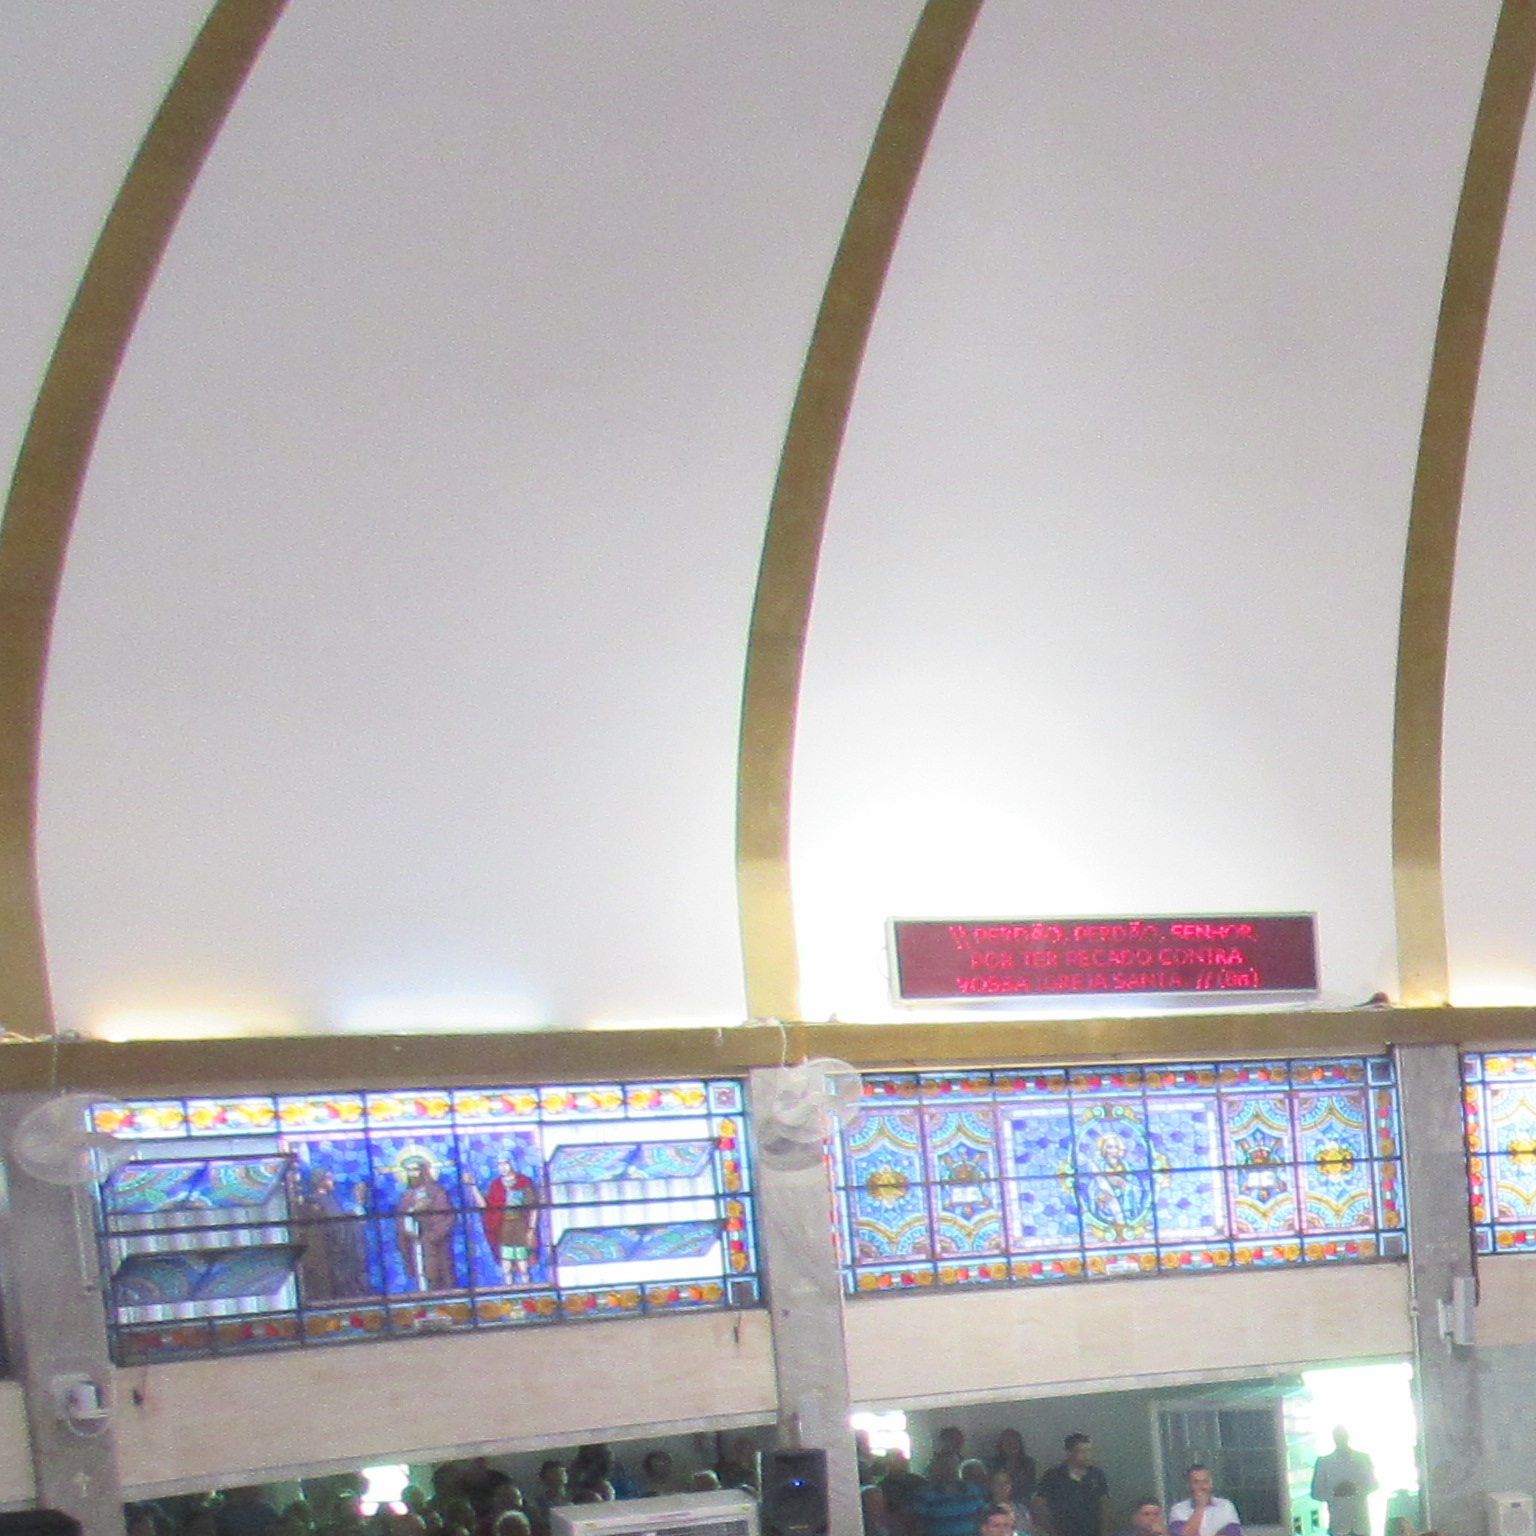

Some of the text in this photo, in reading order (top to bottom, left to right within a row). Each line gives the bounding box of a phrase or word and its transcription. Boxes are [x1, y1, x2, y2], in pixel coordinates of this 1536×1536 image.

[971, 947, 1247, 969] POR TER PECADO CONTRA
